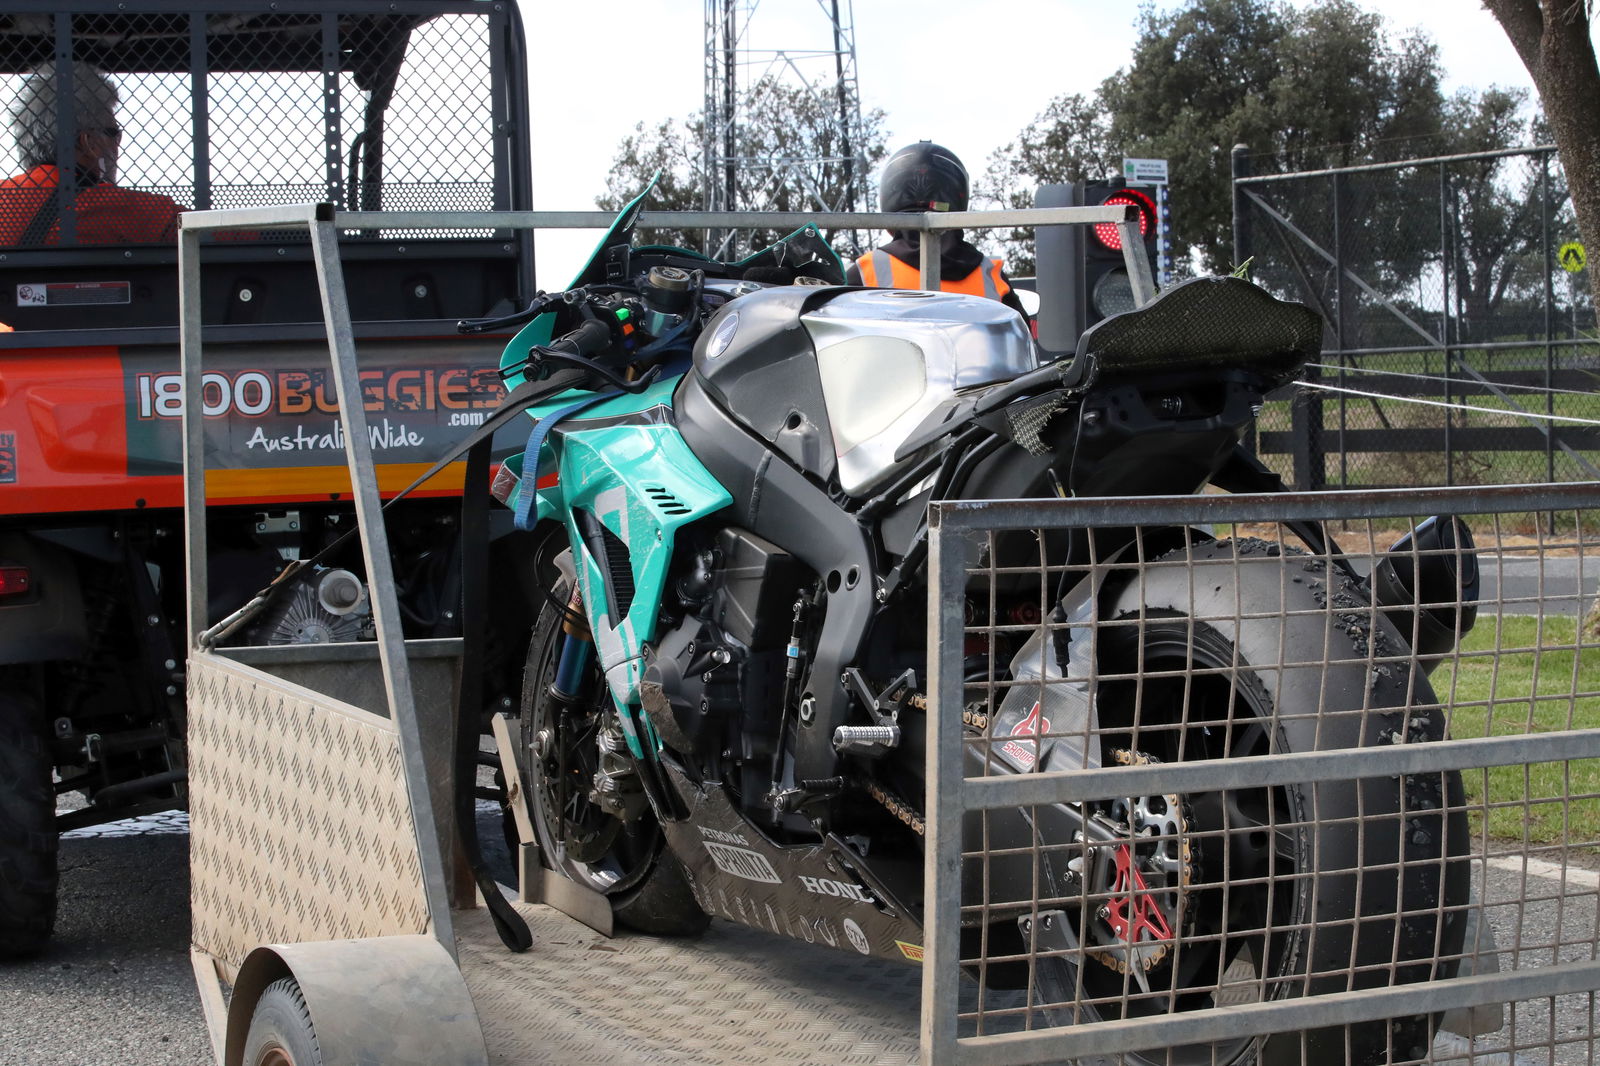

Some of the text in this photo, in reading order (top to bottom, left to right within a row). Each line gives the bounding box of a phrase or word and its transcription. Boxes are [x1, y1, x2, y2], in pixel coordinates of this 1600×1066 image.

[246, 418, 424, 452] Australi Wide
[697, 825, 749, 846] PETRONAS
[709, 845, 777, 881] SPRINTA
